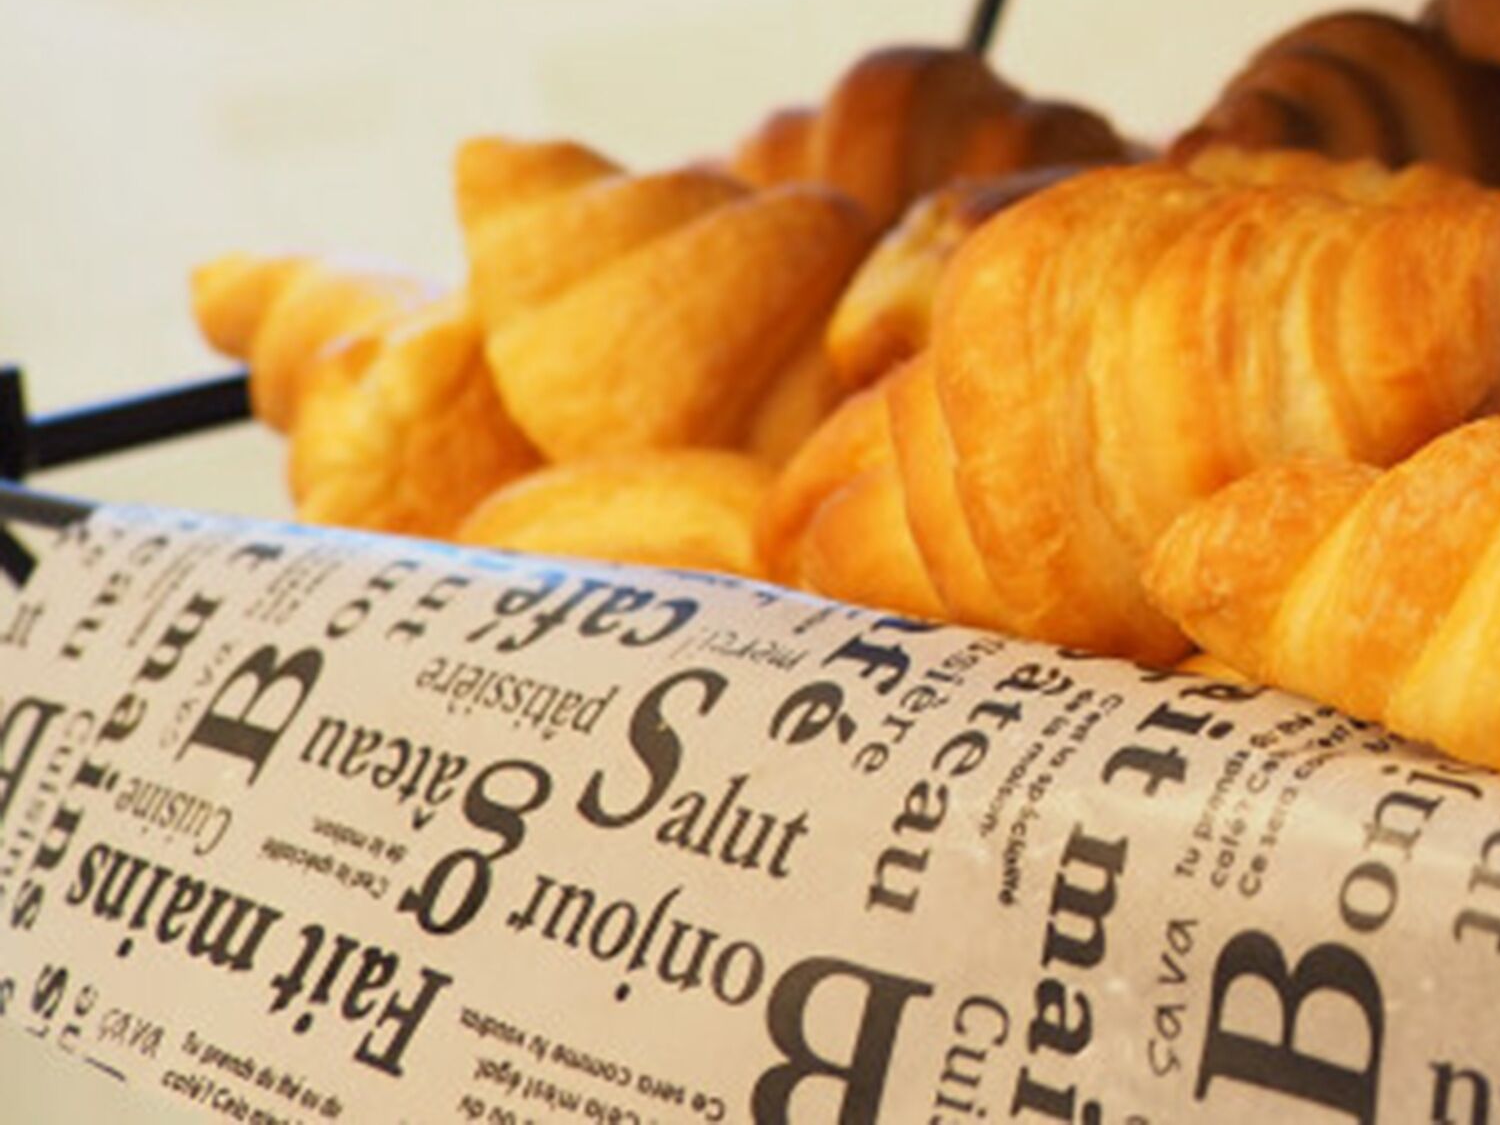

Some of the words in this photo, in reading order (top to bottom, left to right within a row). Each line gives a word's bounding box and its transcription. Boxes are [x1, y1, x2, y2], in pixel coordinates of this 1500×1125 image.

[468, 571, 700, 652] café
[415, 657, 620, 741] pâtissière
[111, 773, 234, 856] Cuisine
[298, 713, 554, 936] gâteau
[576, 668, 810, 878] Salut
[864, 649, 1100, 914] âteau
[65, 843, 284, 972] mains
[268, 924, 454, 1078] Fait
